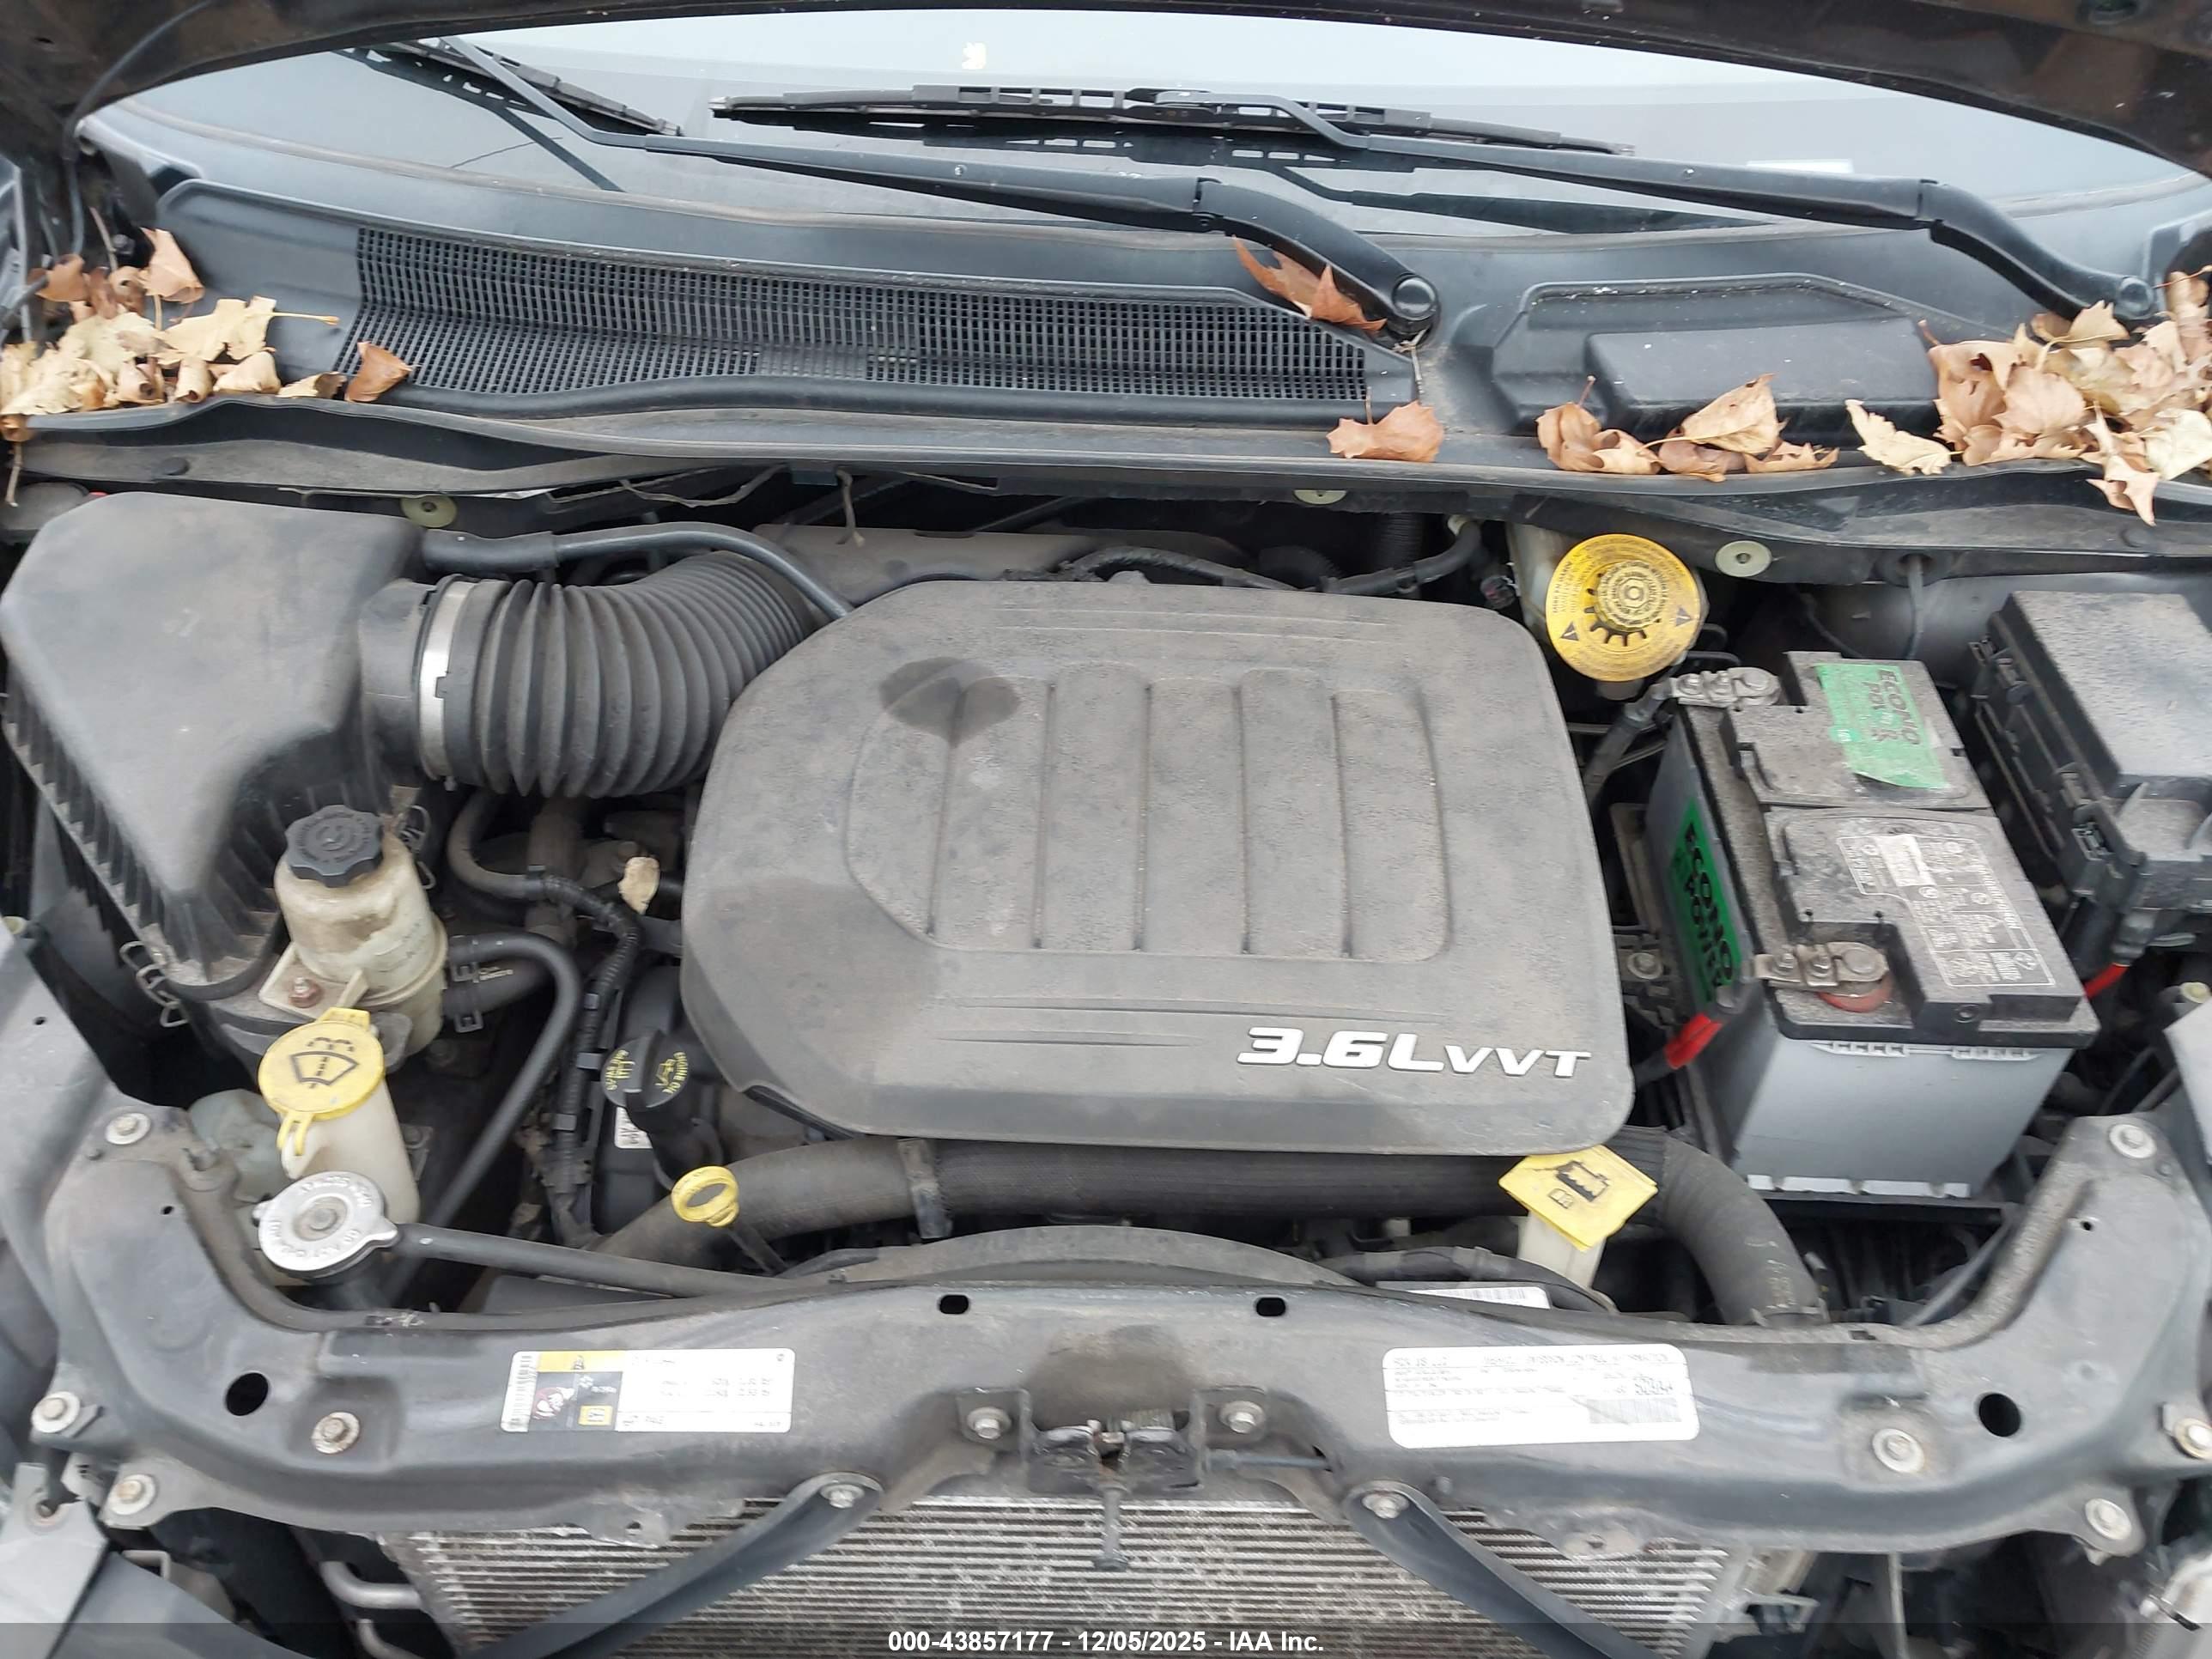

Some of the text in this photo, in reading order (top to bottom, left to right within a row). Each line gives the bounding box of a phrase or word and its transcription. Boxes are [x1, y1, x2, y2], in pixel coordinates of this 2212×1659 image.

[1877, 669, 1921, 745] ECONO
[1685, 822, 1733, 981] ECONO
[661, 1049, 689, 1095] ENGINE OIL
